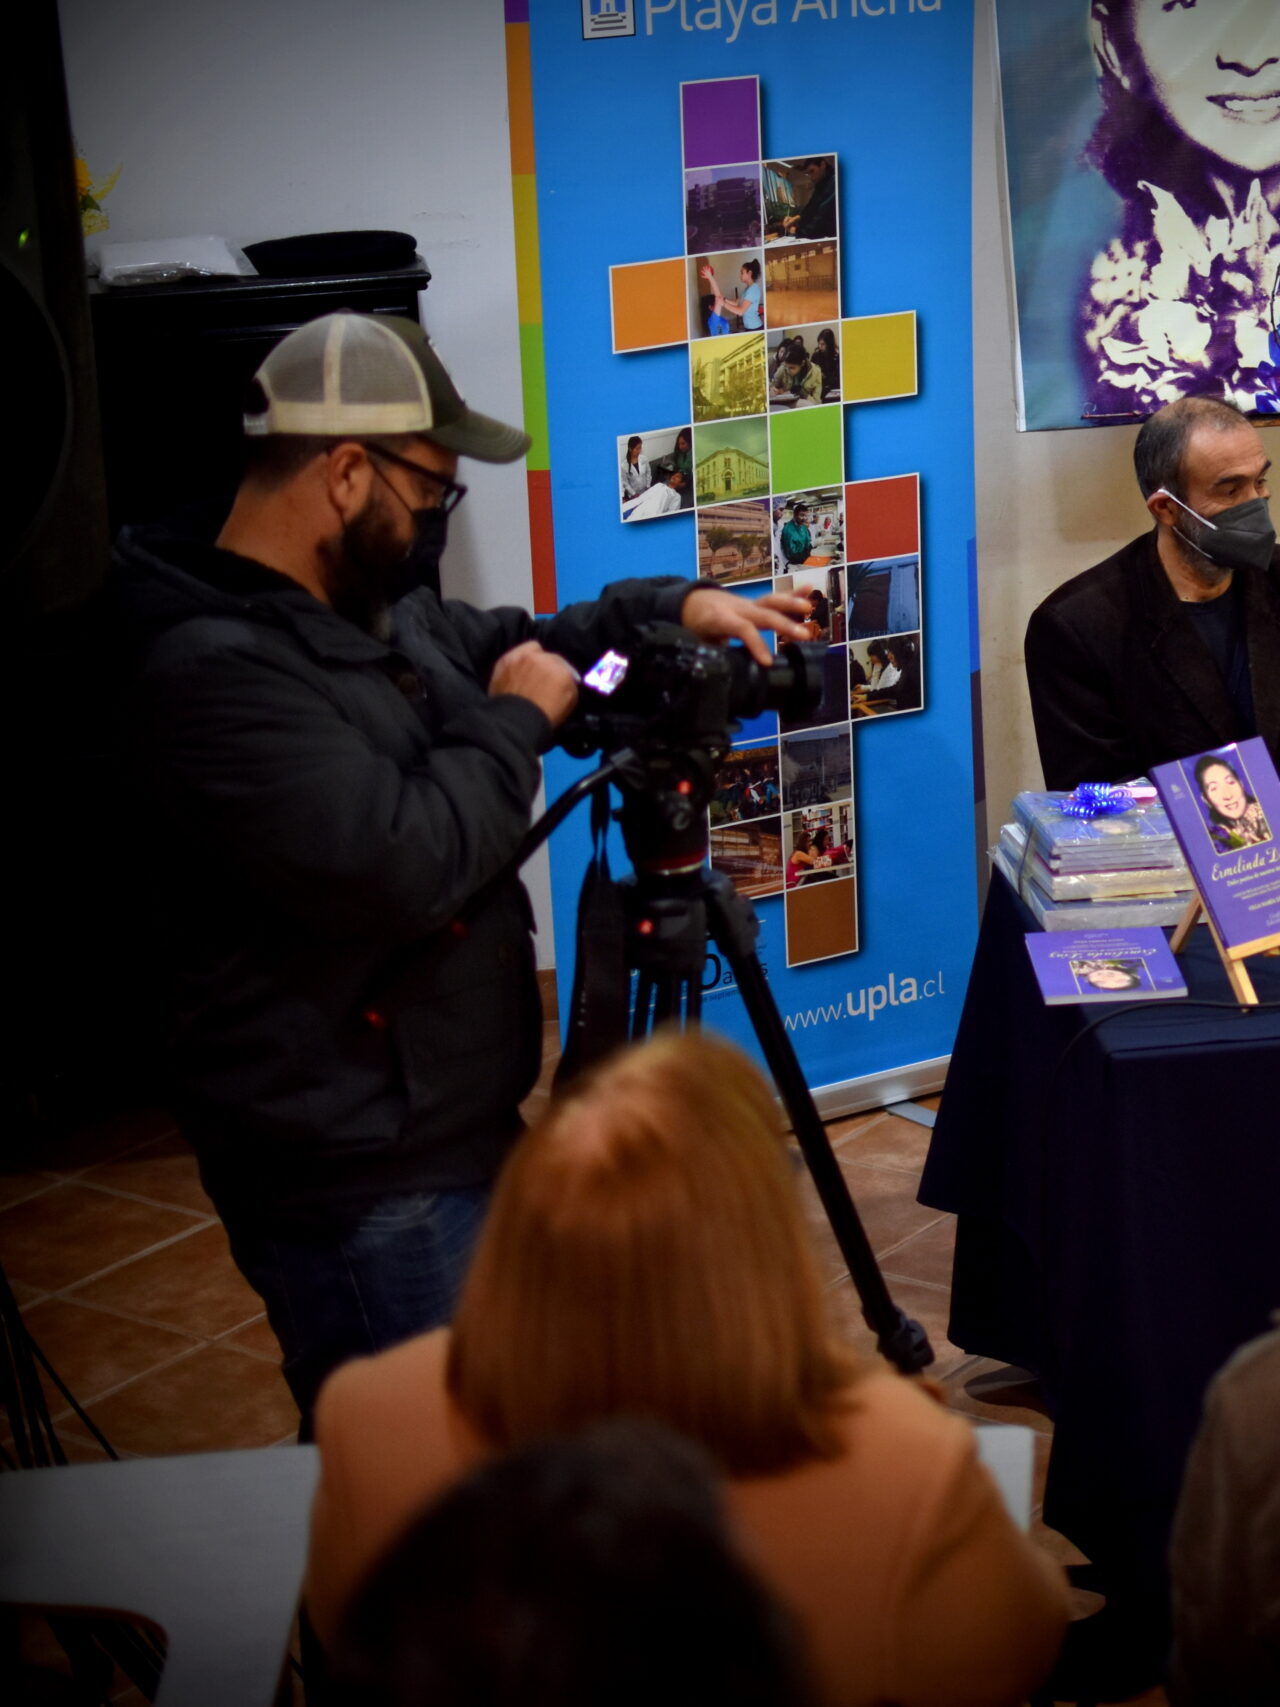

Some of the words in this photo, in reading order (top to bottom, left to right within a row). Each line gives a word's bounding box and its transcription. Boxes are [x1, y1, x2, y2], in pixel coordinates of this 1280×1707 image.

[646, 0, 777, 43] Playa
[1211, 853, 1266, 881] Ermelinda
[784, 970, 945, 1031] www.upla.cl
